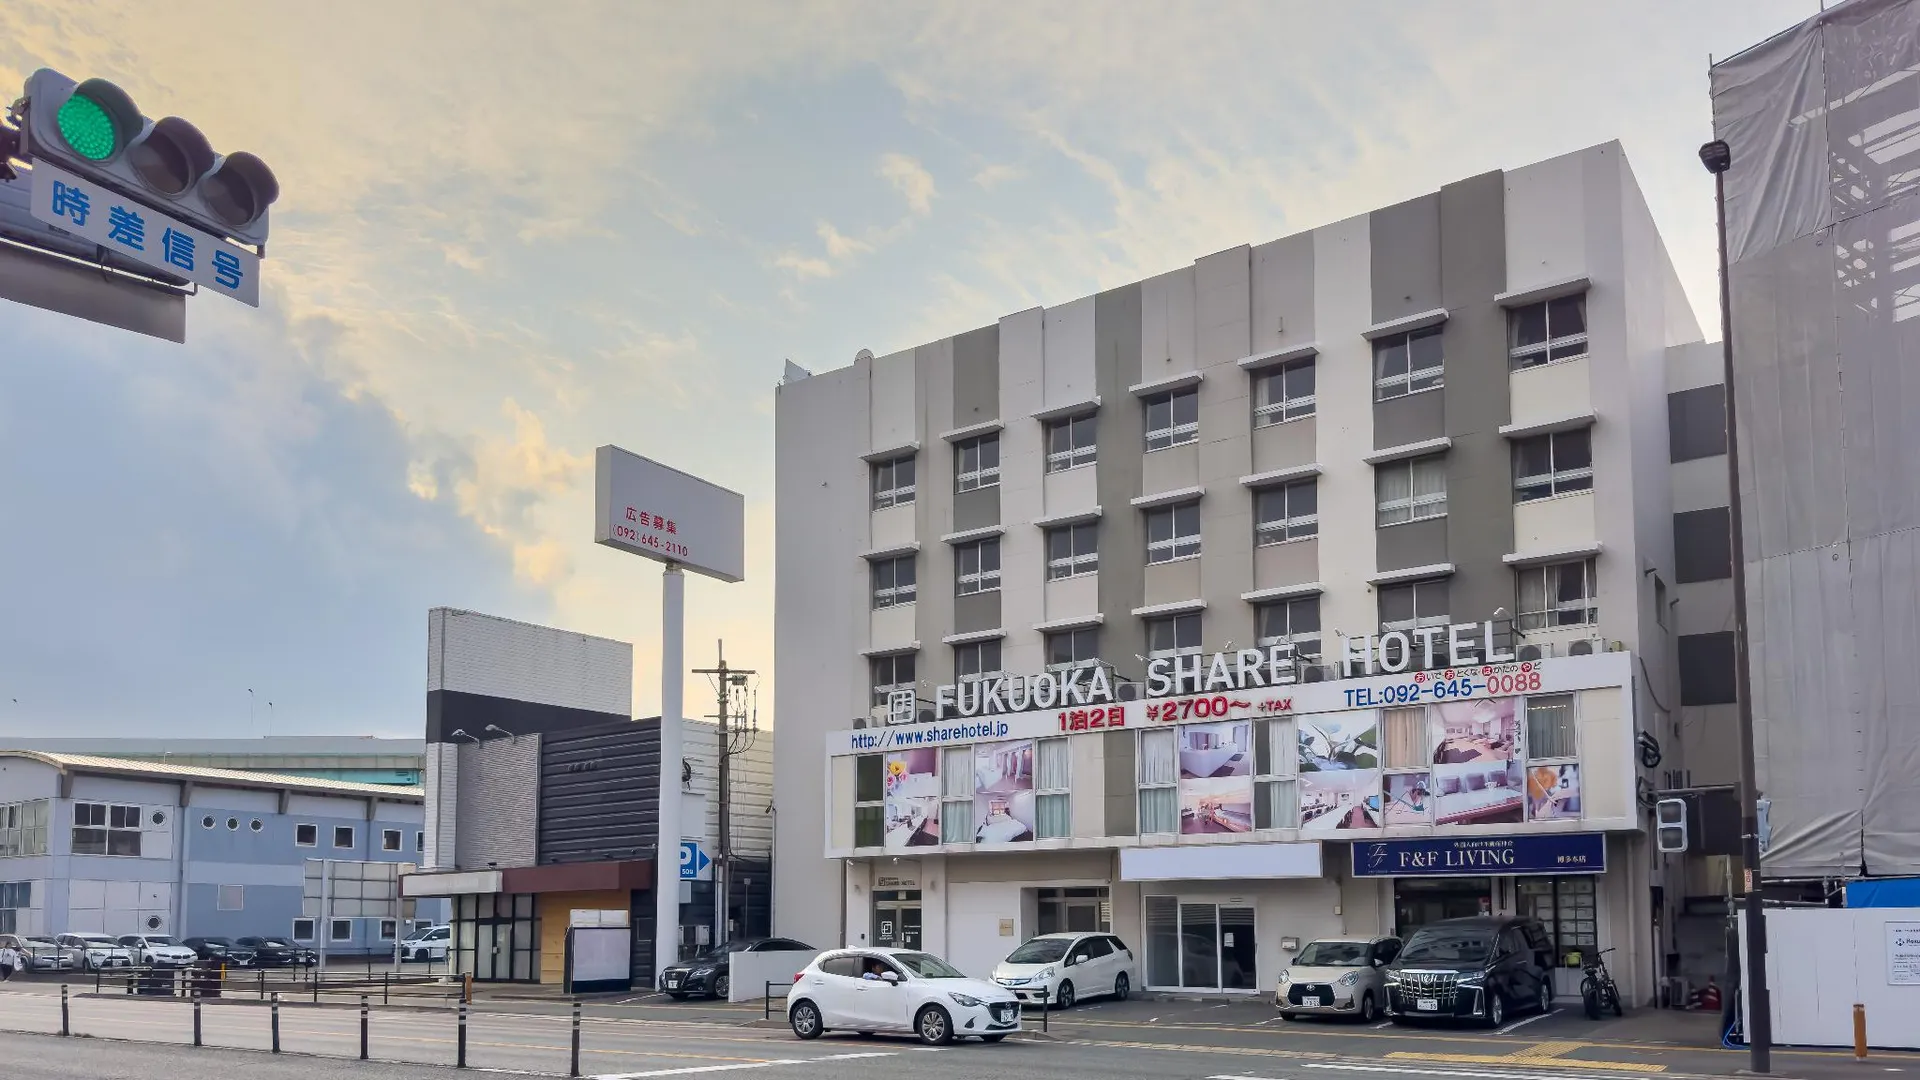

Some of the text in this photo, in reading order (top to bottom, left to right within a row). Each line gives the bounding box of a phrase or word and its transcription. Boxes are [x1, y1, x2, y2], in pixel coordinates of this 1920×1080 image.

[51, 180, 243, 290] 時差信号
[626, 506, 677, 535] 広告募集
[936, 620, 1515, 719] FUKUOKA SHARE HOTEL
[1343, 671, 1542, 708] TEL:092-645-0088
[1058, 705, 1126, 732] 1泊2日
[851, 720, 1009, 750] http://www.sharehotel.jp
[1399, 849, 1515, 867] F&F LIVING
